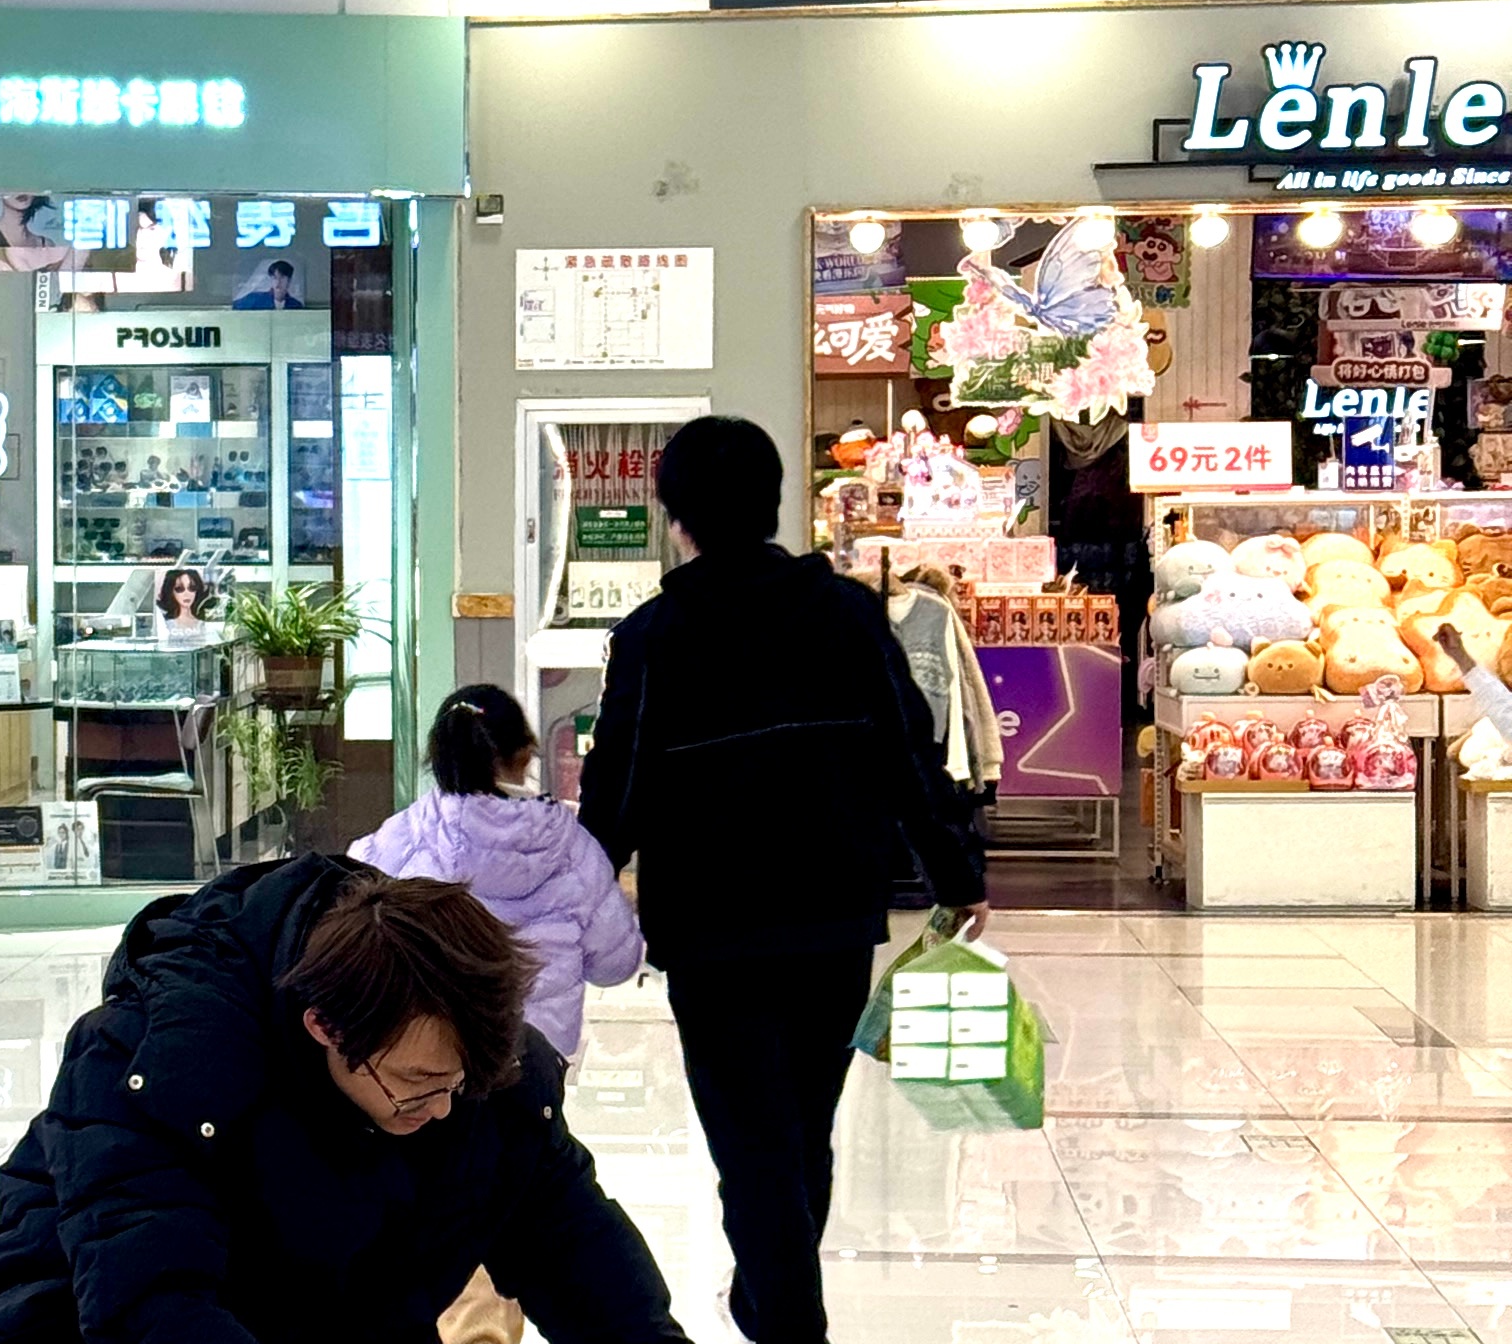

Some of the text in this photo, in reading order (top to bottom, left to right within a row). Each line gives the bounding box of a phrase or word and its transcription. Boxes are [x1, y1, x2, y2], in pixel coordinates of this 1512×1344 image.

[1182, 57, 1506, 151] Lenle
[1277, 167, 1511, 192] All in life goods Since
[38, 274, 49, 308] OLON
[116, 326, 222, 348] PROSUN
